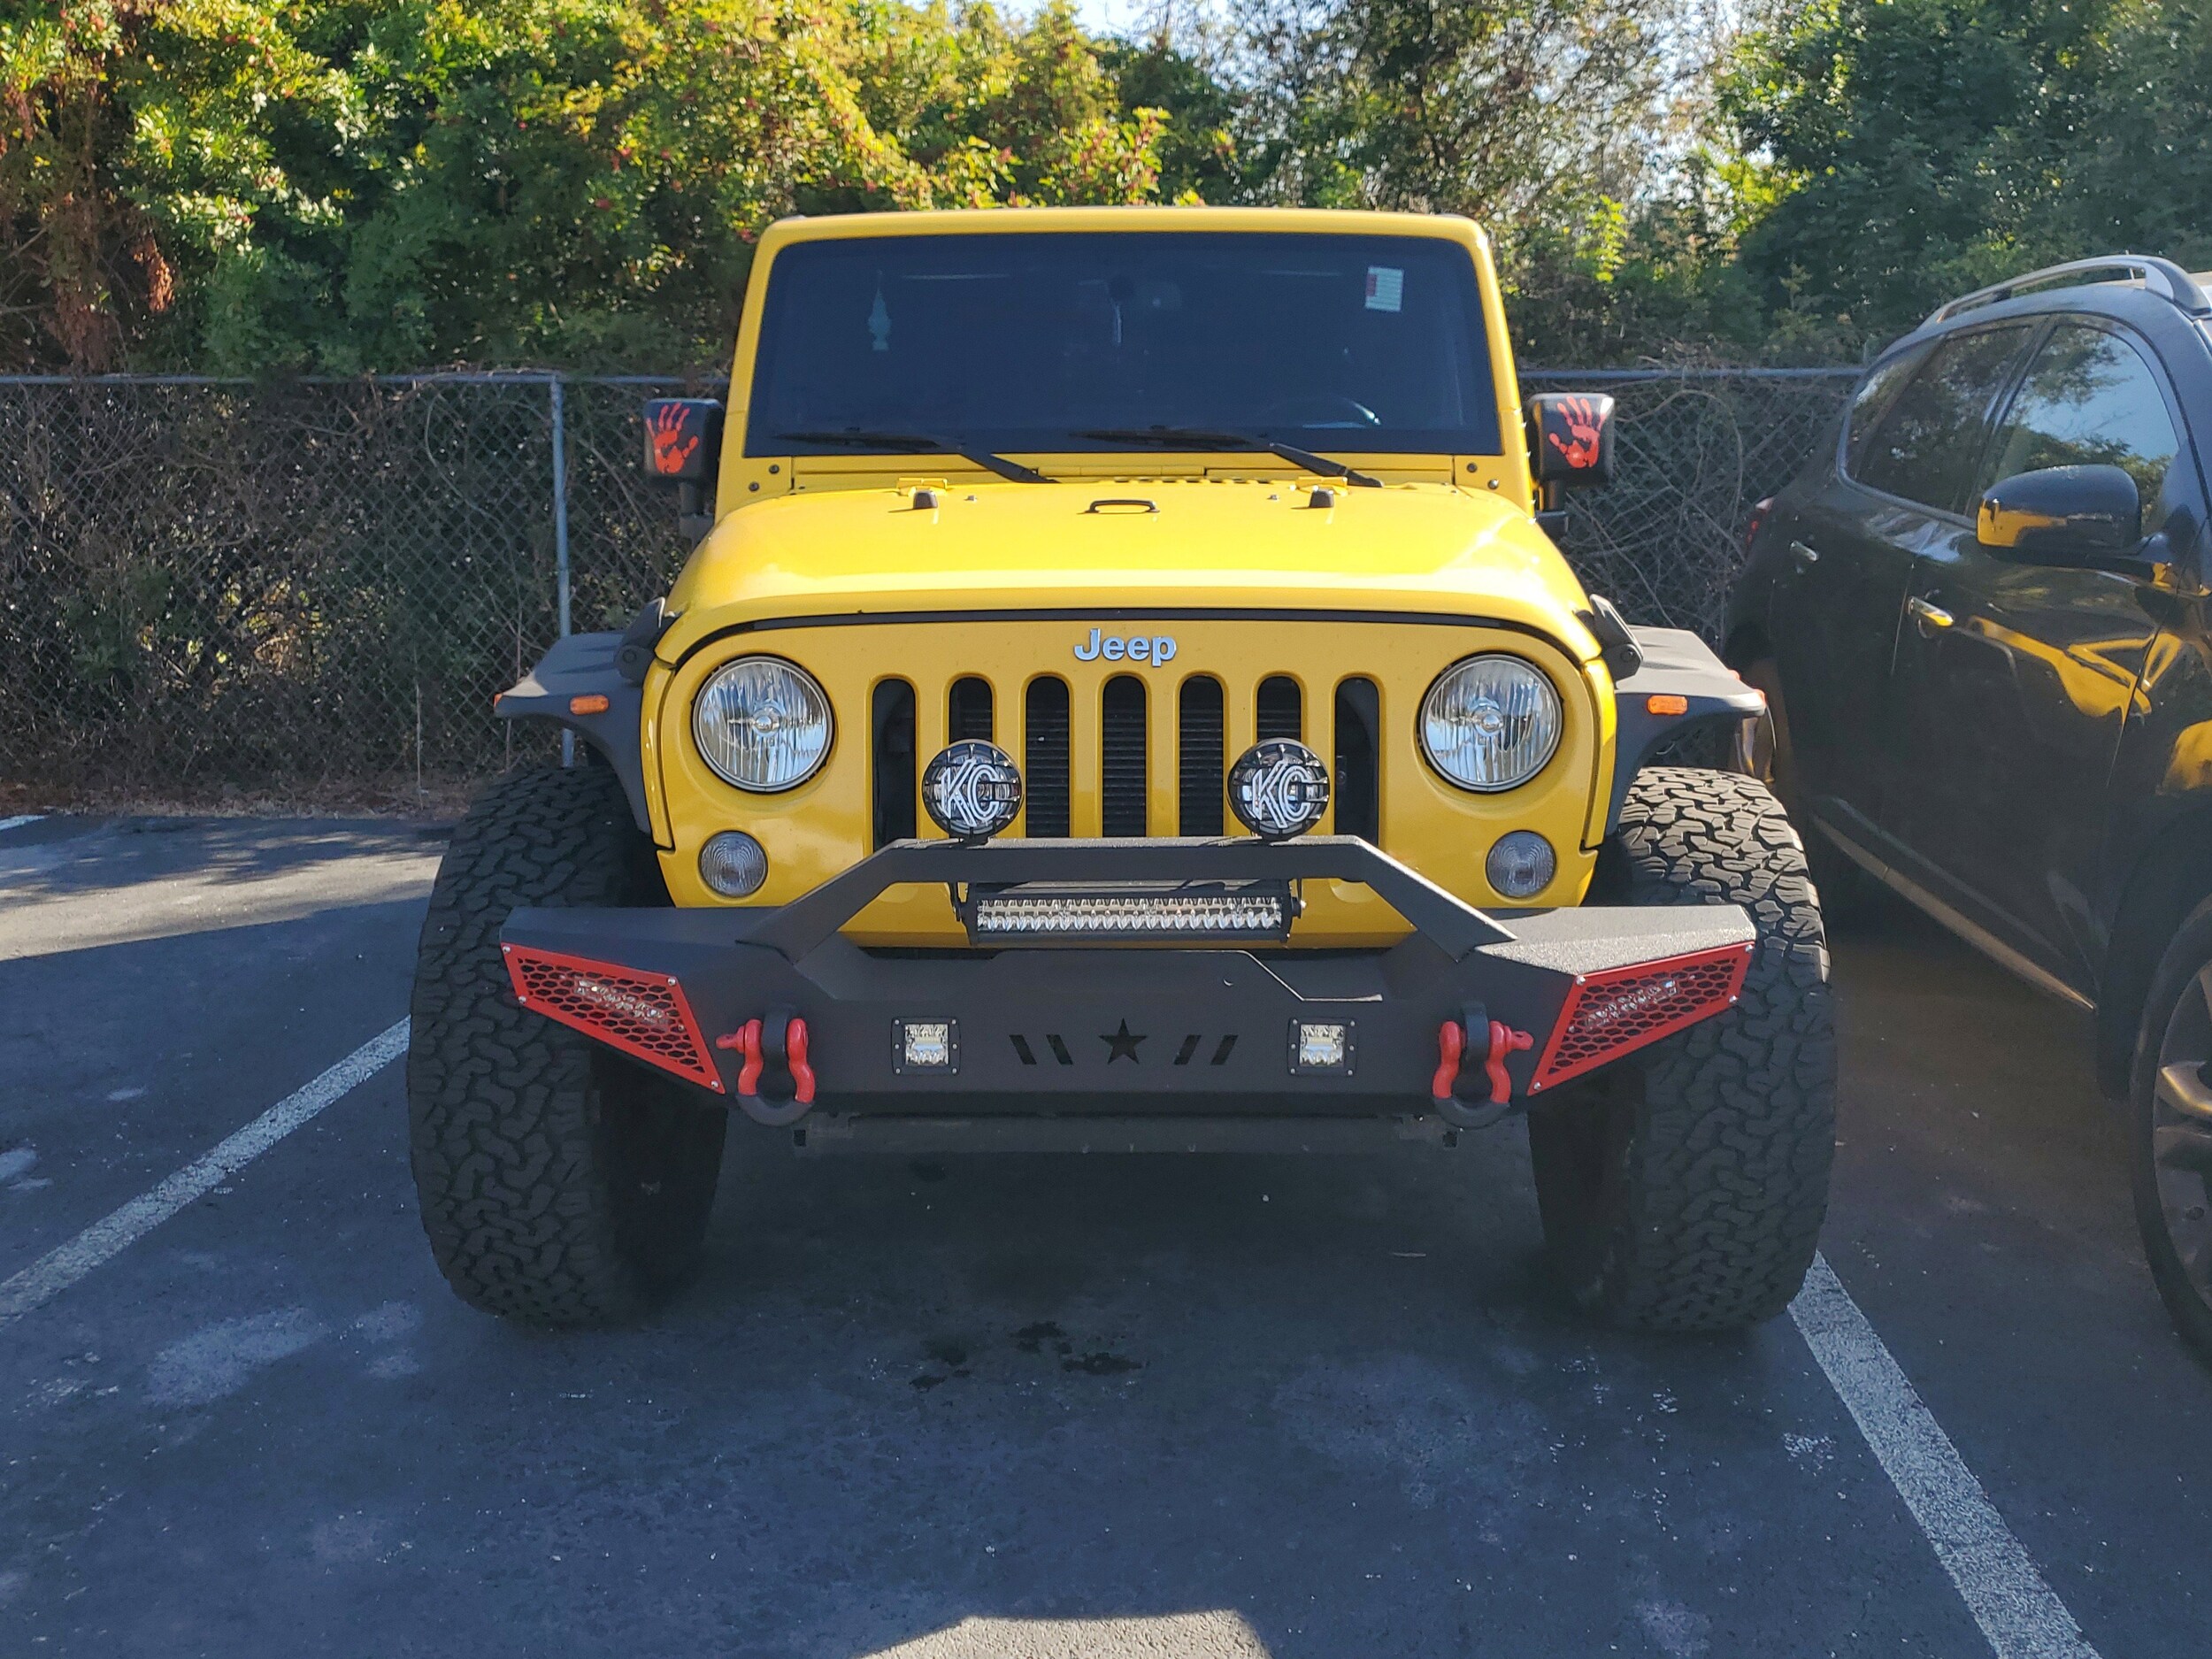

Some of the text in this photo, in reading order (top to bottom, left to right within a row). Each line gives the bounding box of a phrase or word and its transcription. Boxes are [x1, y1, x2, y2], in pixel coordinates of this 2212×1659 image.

[1073, 628, 1177, 667] Jeep
[941, 757, 1000, 827] KC
[1252, 760, 1311, 828] KC
